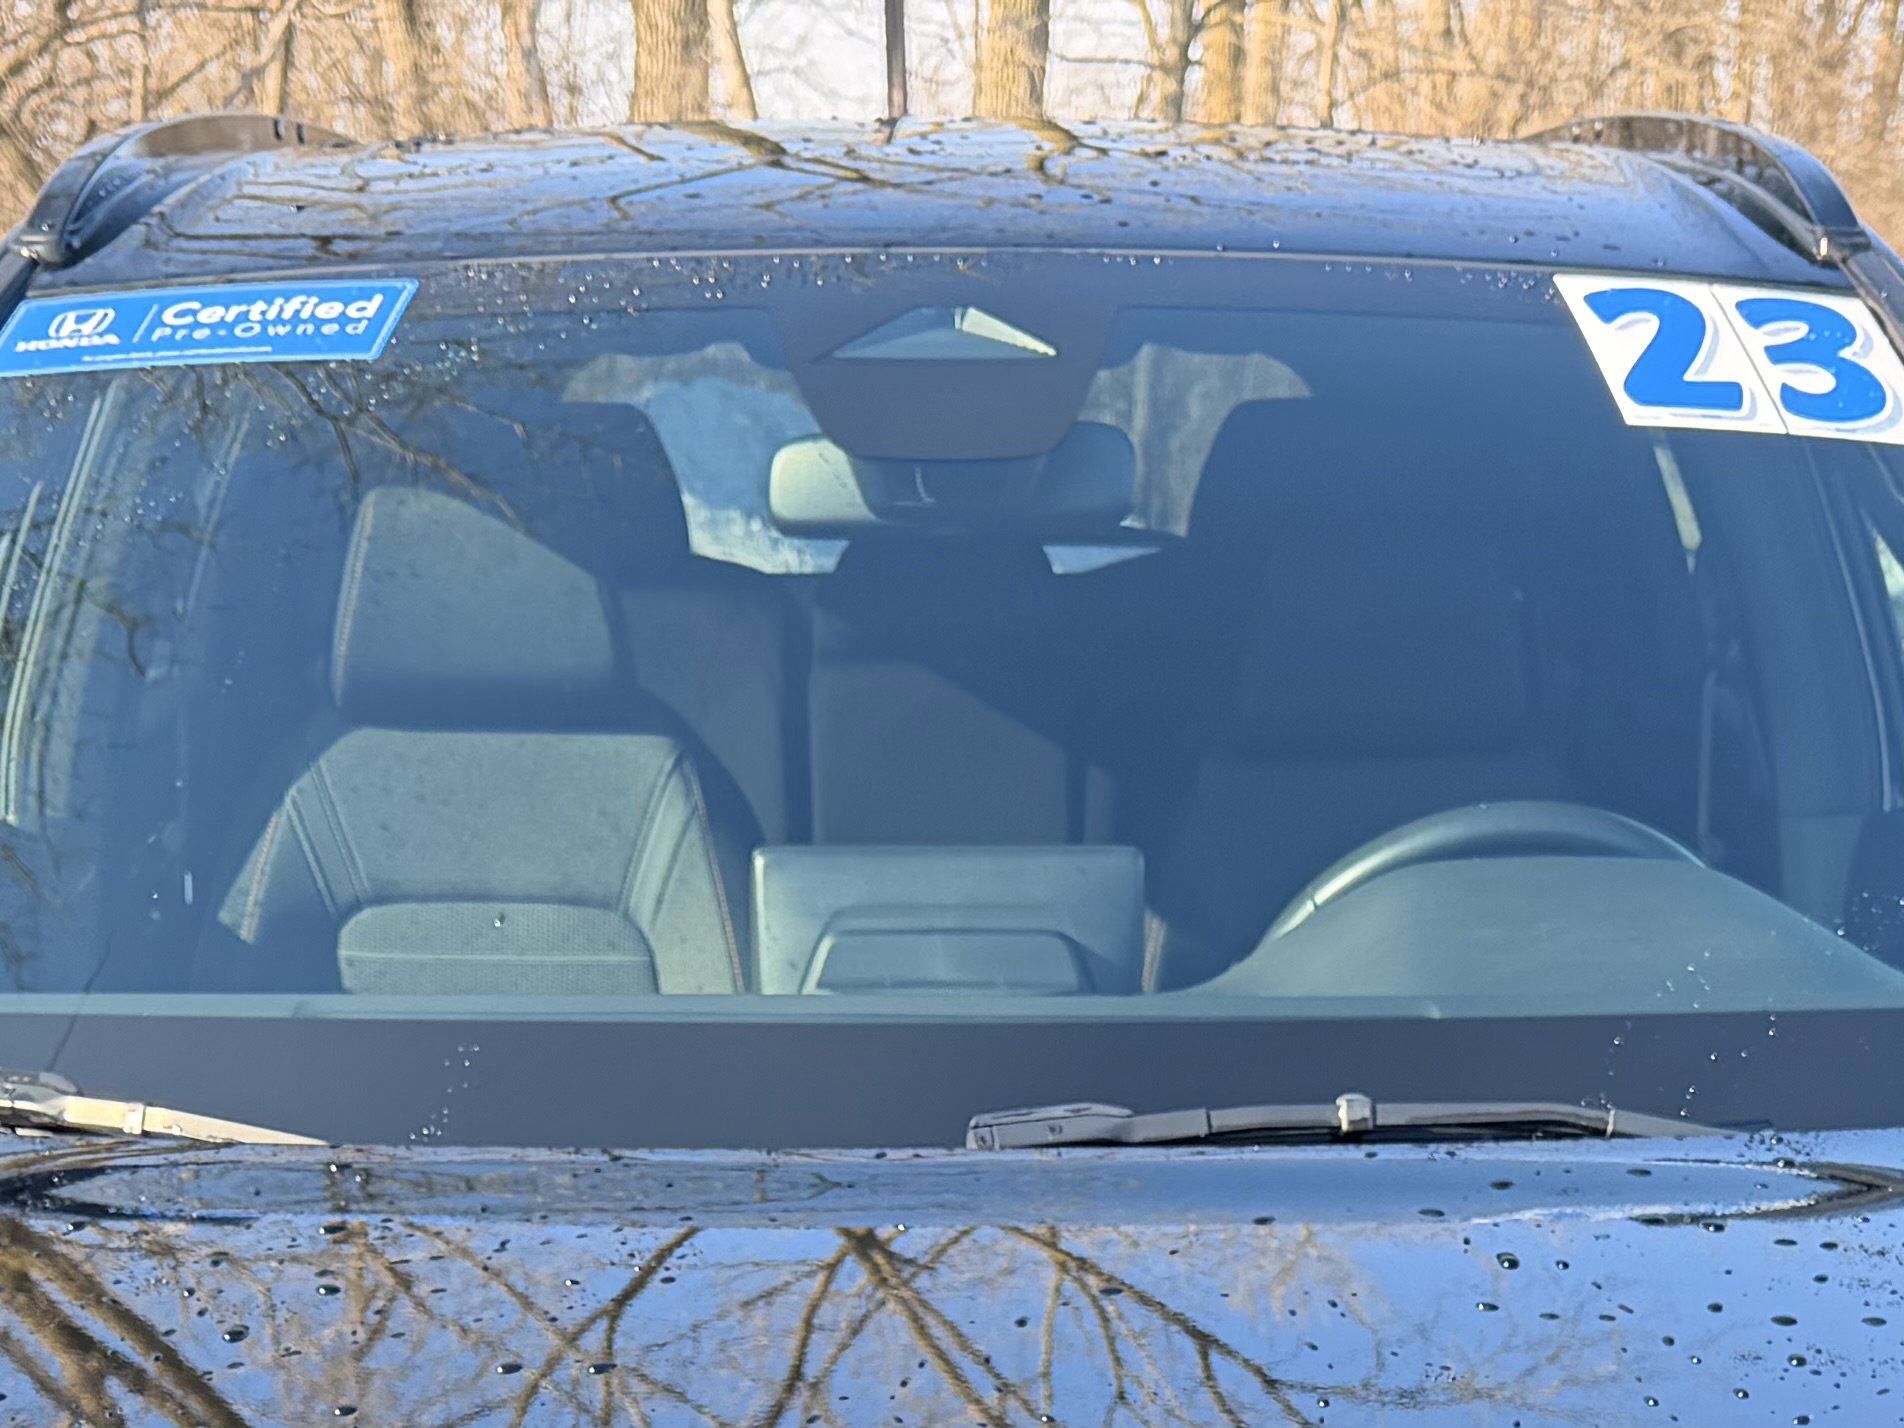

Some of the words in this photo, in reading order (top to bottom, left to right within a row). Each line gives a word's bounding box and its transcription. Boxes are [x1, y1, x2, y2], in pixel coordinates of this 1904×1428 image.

[161, 294, 384, 325] Certified
[15, 334, 120, 352] HONDA
[1583, 288, 1886, 423] 23
